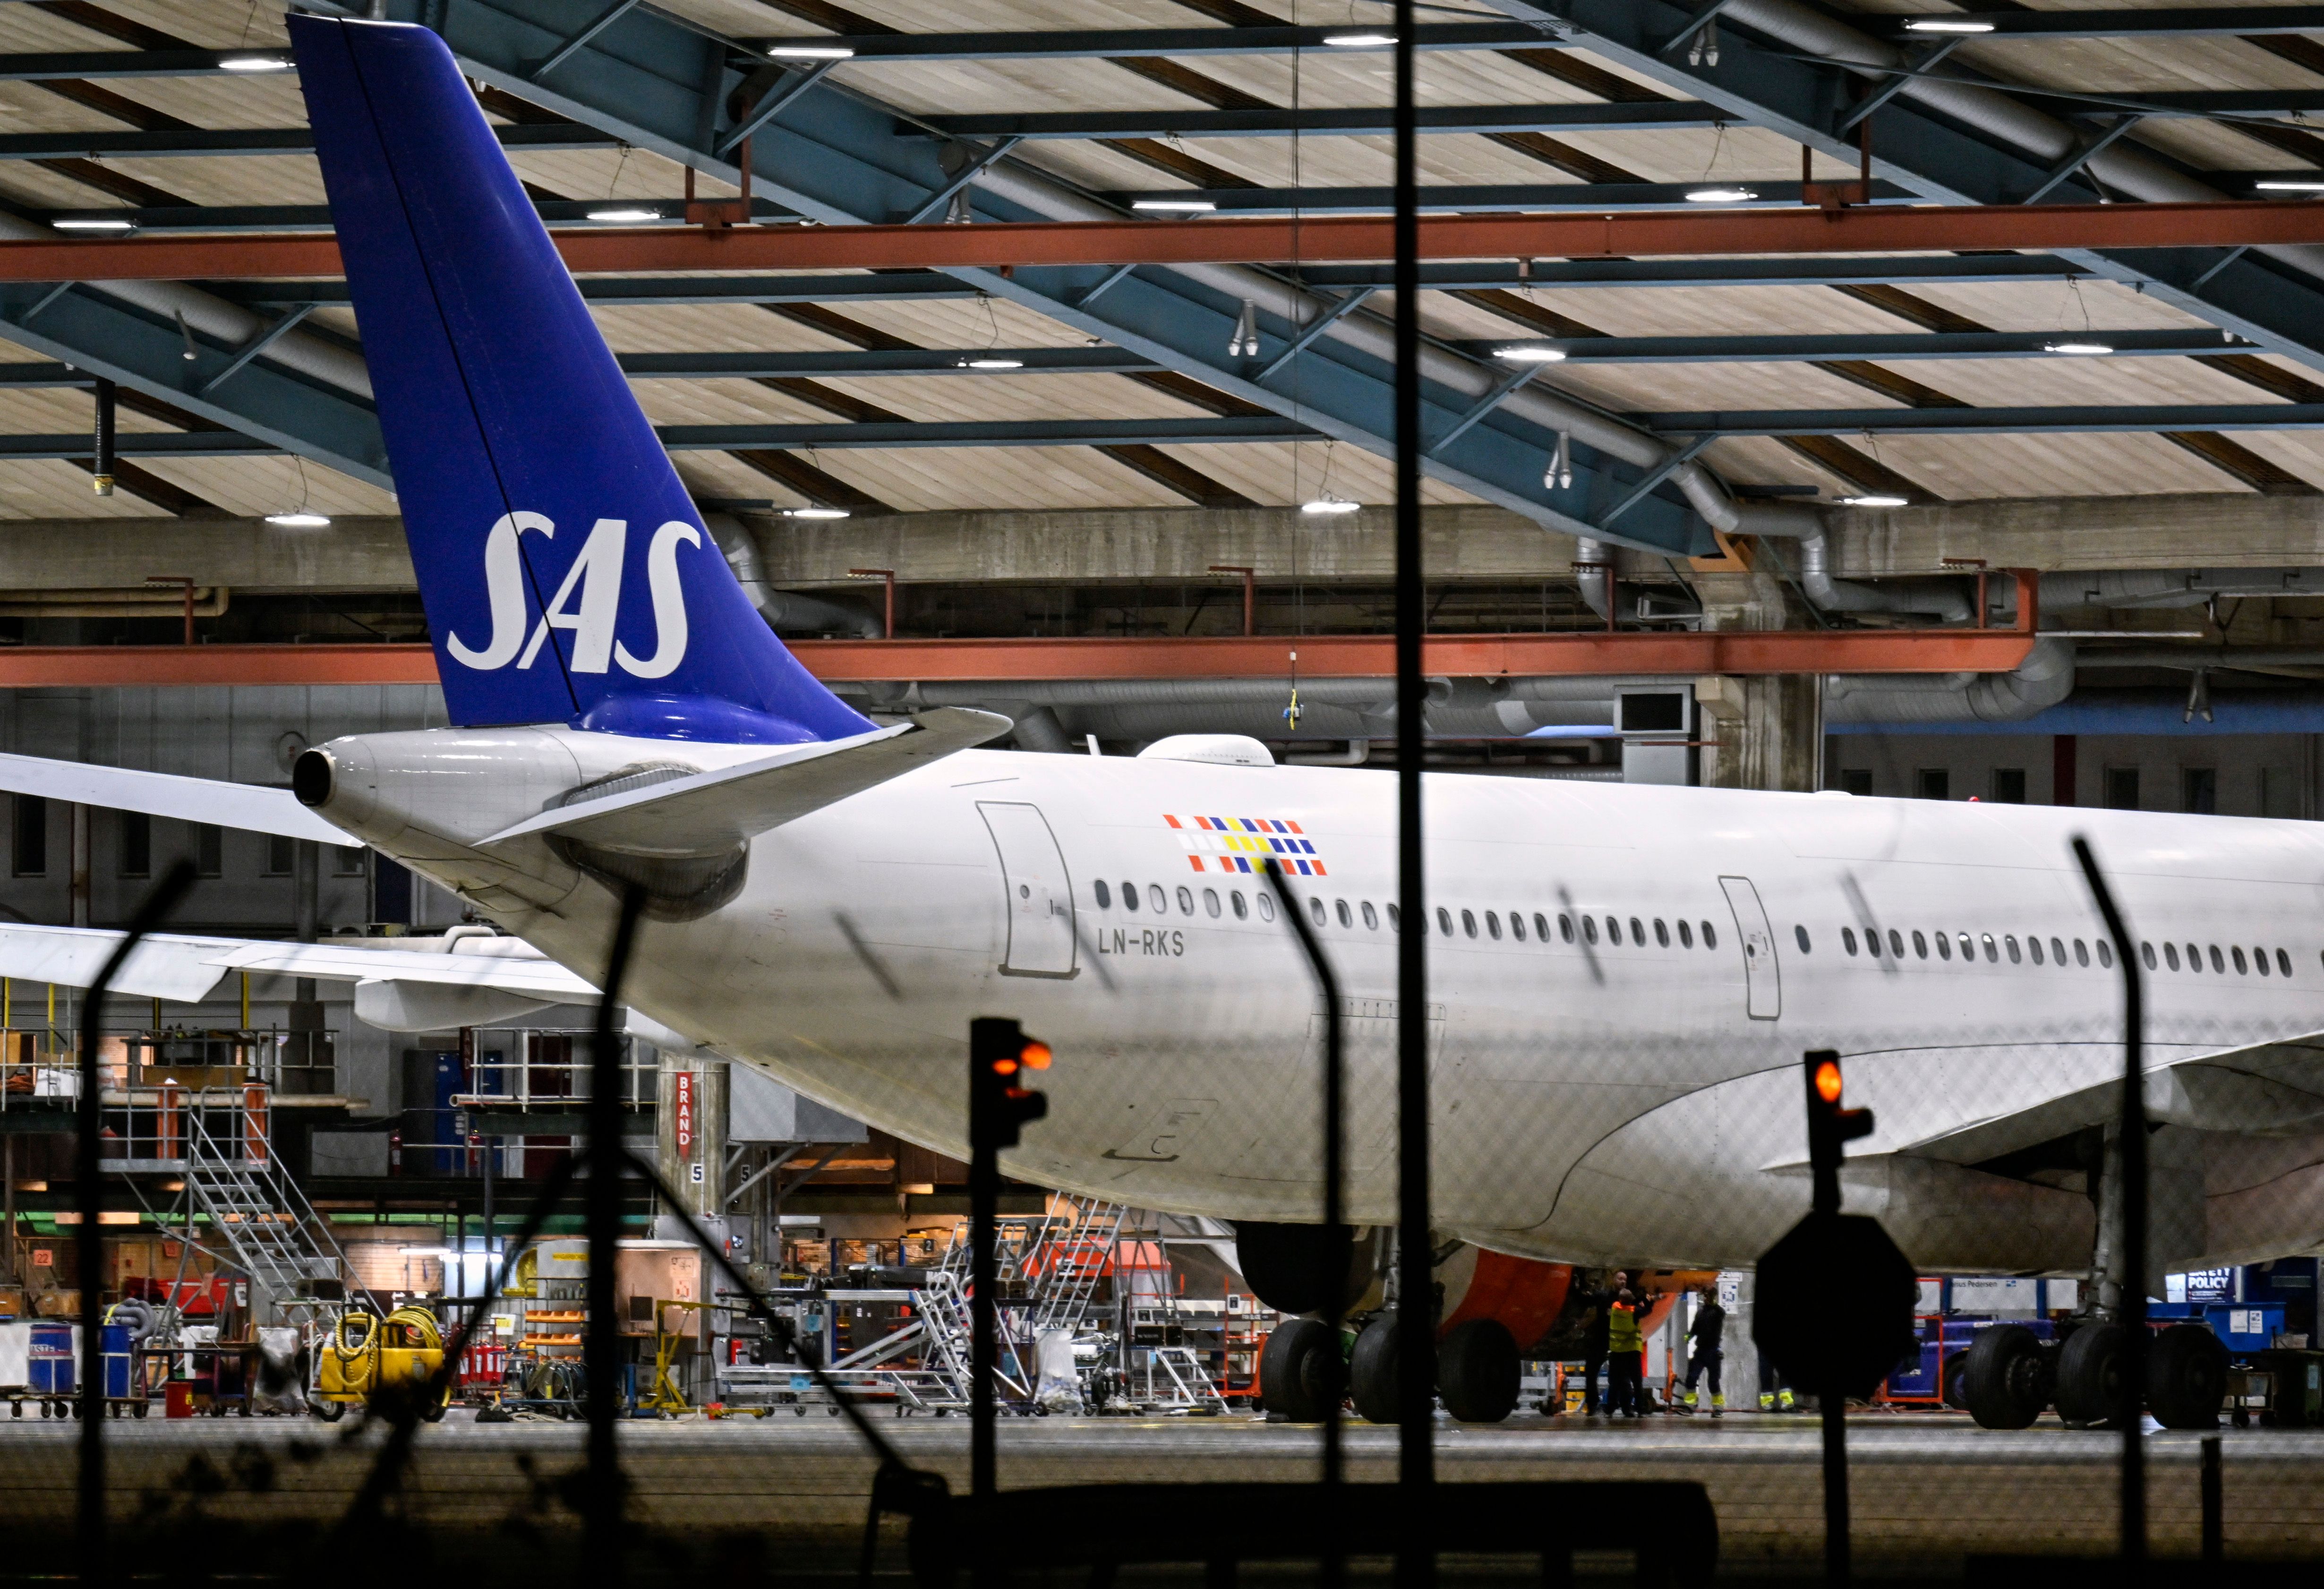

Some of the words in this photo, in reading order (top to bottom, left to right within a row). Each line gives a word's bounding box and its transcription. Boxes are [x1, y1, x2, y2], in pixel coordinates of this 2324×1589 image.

[447, 511, 701, 679] SAS
[1098, 928, 1184, 957] LN-RKS
[679, 1076, 690, 1145] BRAND
[693, 1166, 702, 1181] 5
[742, 1166, 750, 1181] 5
[925, 1240, 931, 1251] 2
[37, 1253, 49, 1263] 22
[2188, 1276, 2229, 1289] POLICY
